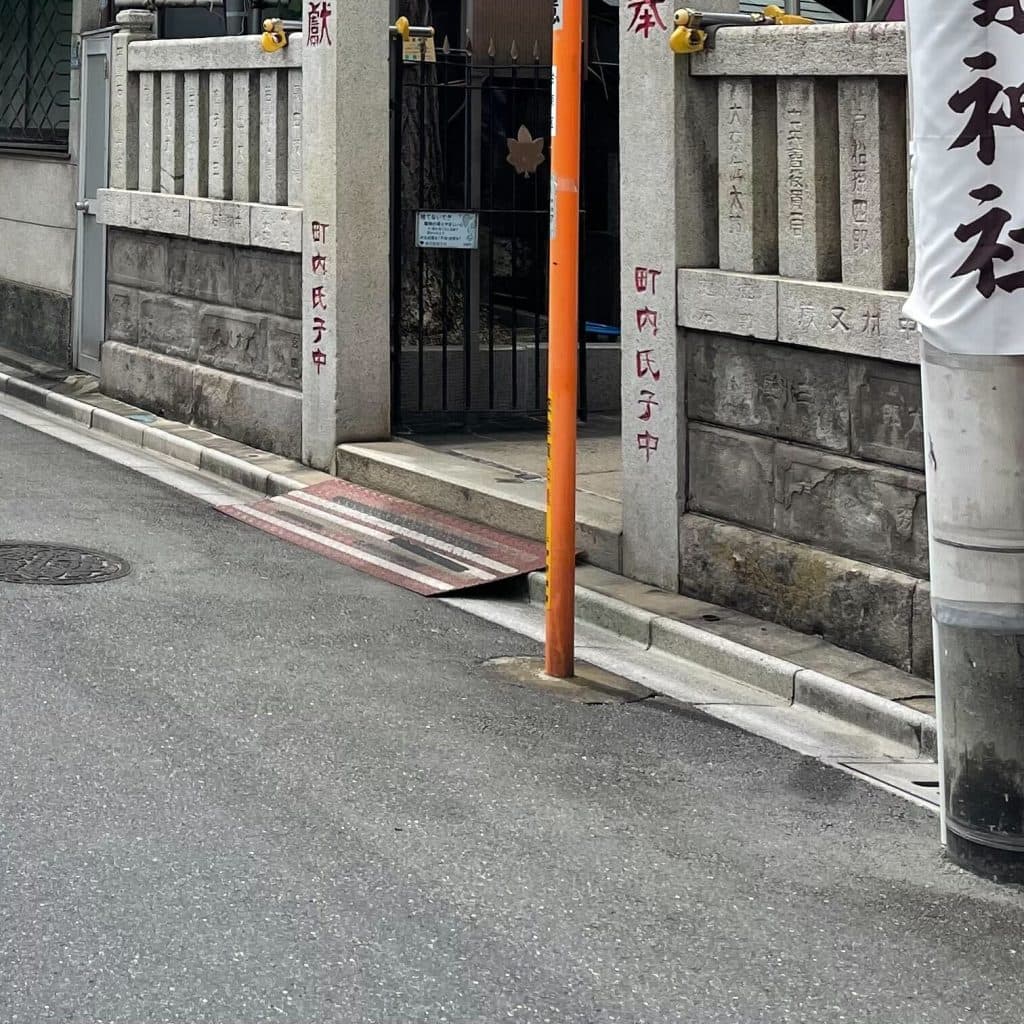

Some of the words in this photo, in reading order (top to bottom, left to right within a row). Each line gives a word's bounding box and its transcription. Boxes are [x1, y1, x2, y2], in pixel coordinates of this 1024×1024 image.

[312, 220, 329, 376] 町内氏子中
[634, 266, 662, 464] 町内氏子中
